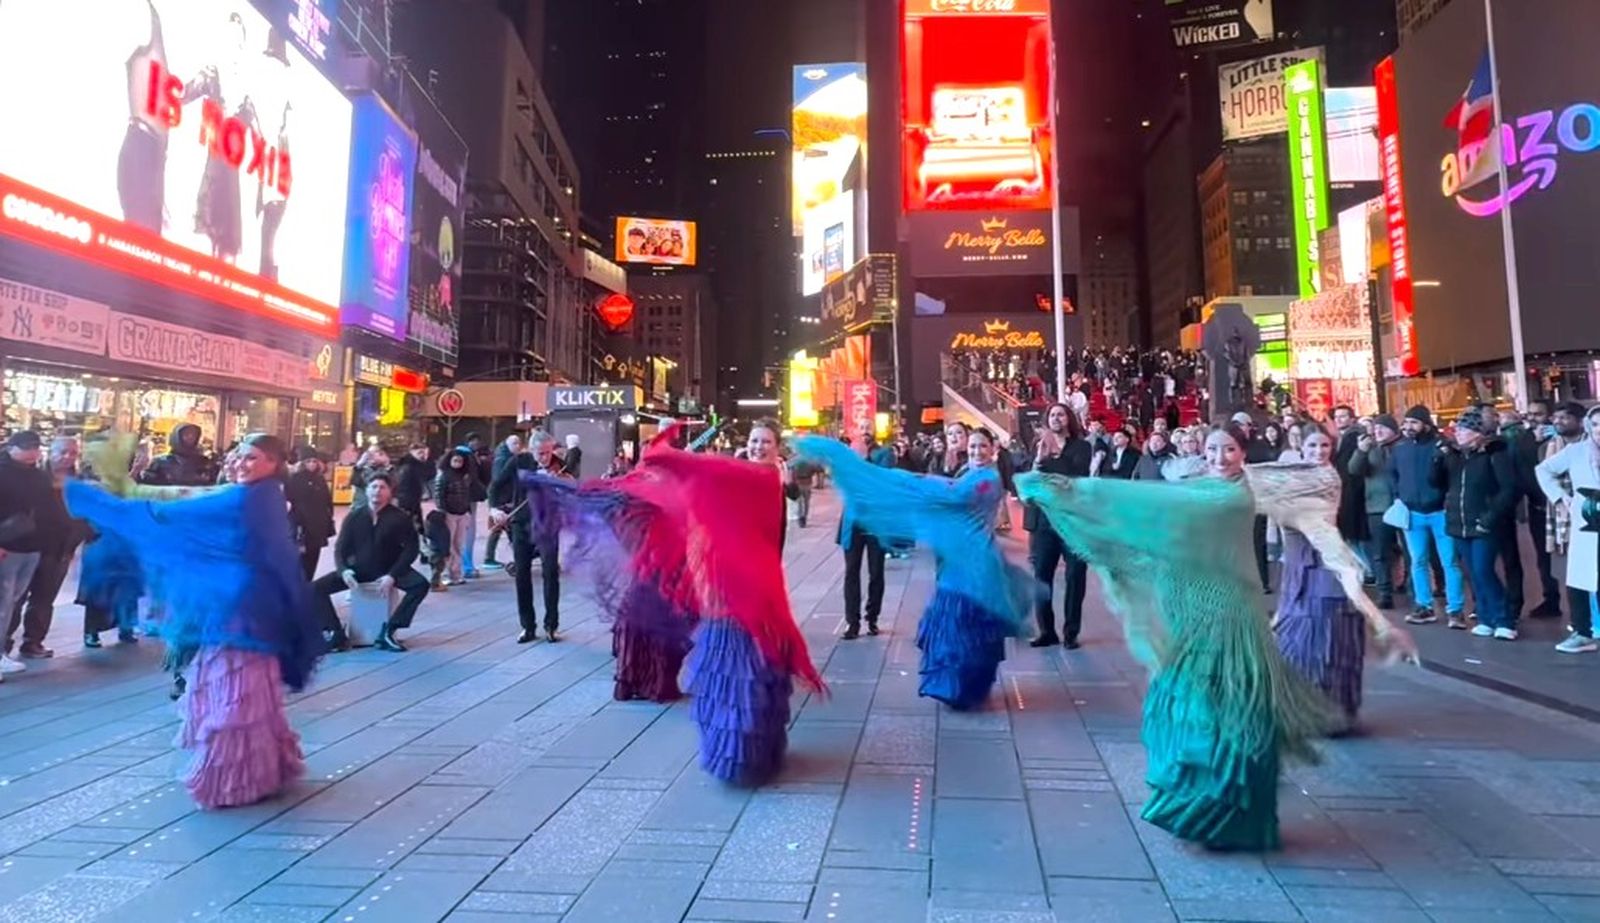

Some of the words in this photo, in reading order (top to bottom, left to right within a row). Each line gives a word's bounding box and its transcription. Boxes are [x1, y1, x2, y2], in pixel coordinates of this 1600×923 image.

[147, 60, 184, 129] IS
[1229, 58, 1277, 89] LITTLE
[1297, 96, 1319, 262] CANNABIS
[944, 231, 1002, 254] Merry
[1003, 228, 1047, 247] Belle
[1390, 226, 1407, 280] STORE
[951, 332, 1004, 349] Merry
